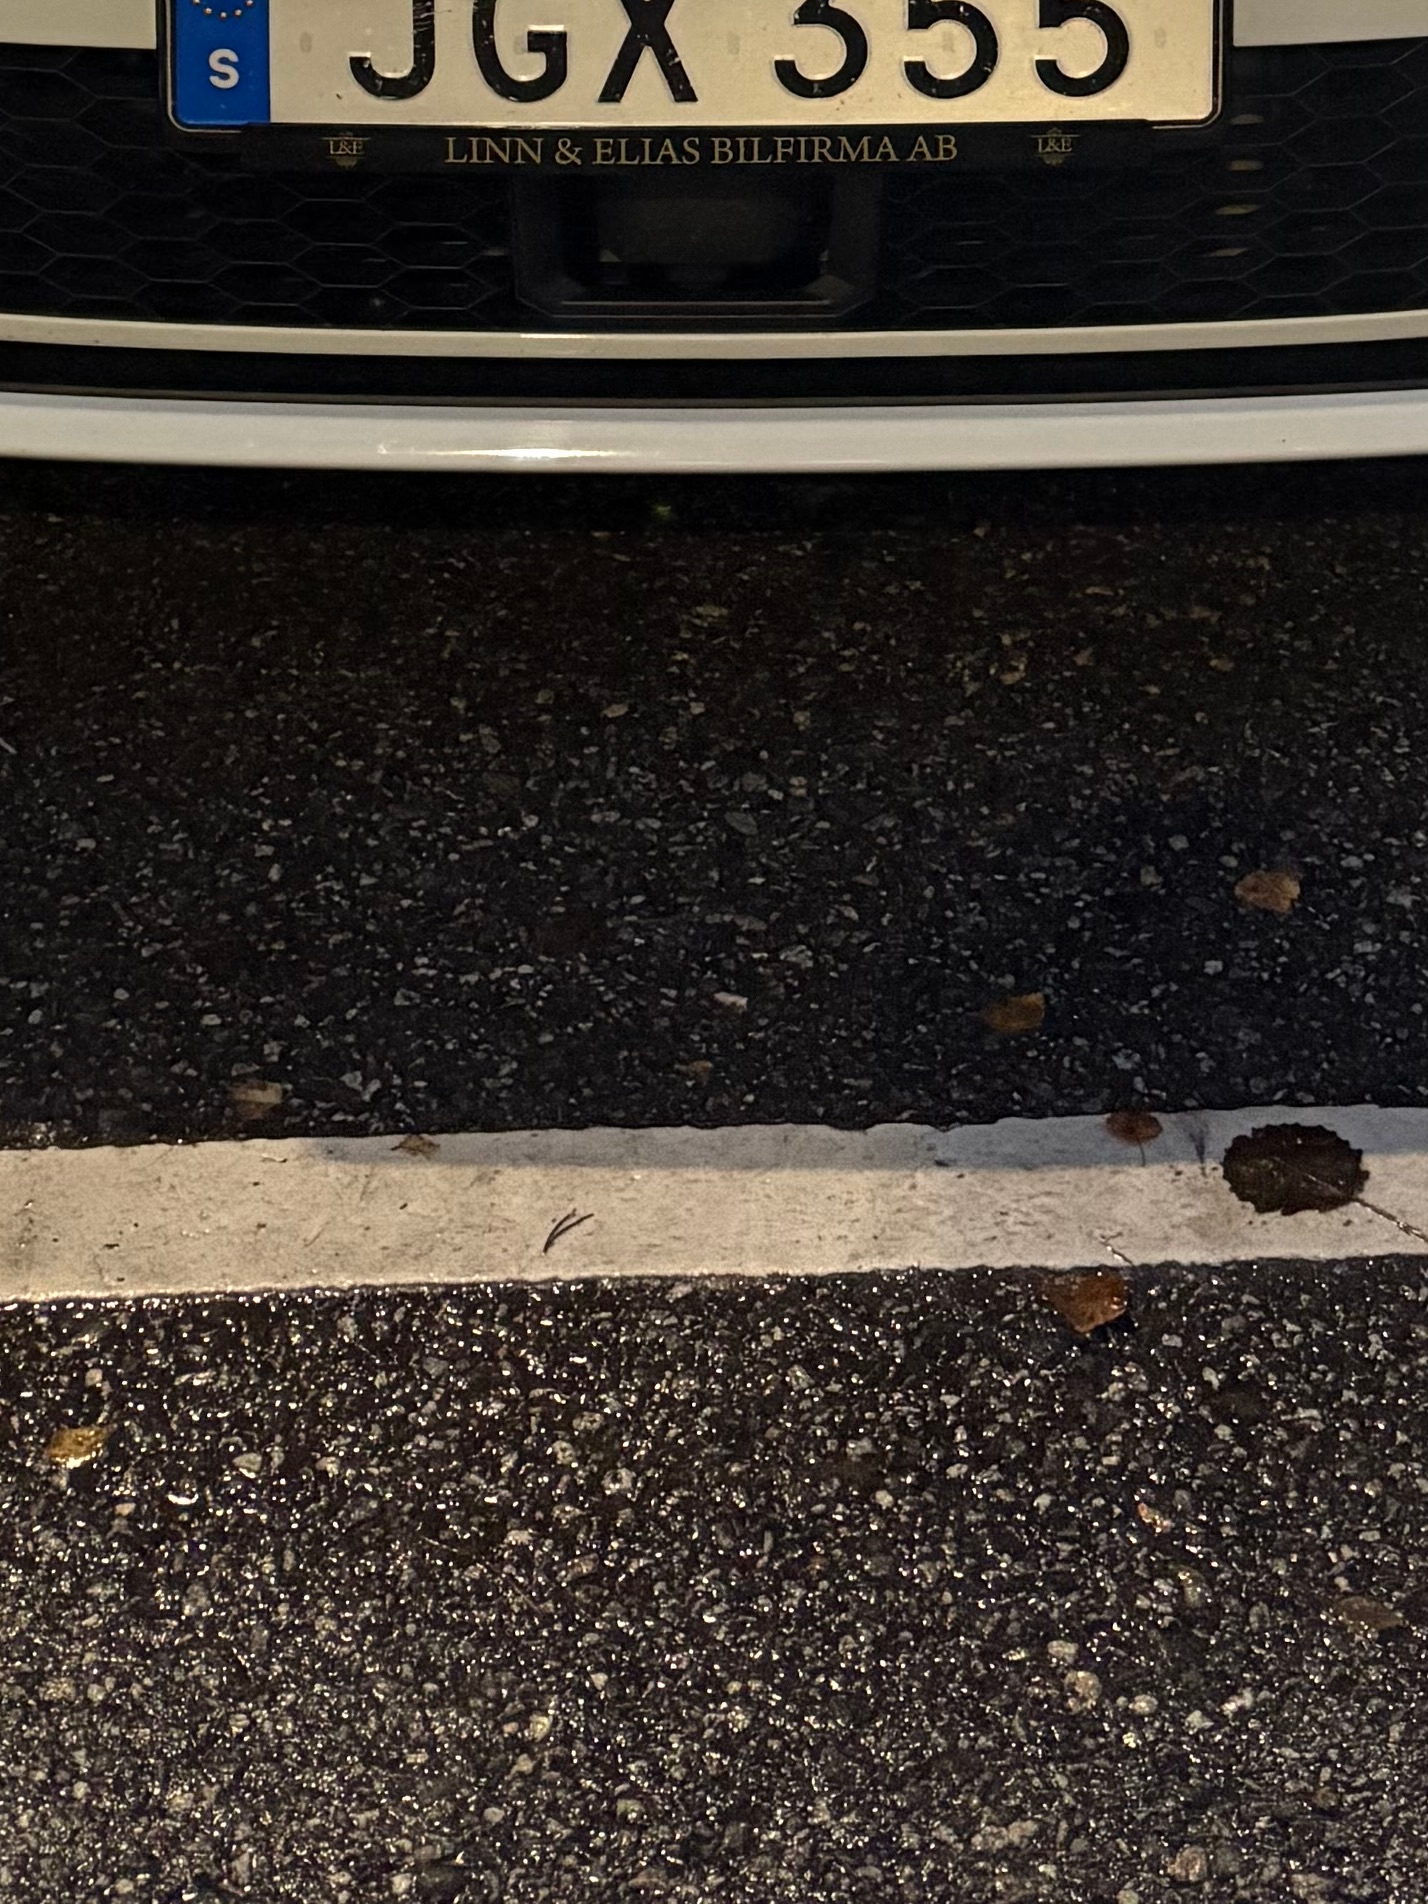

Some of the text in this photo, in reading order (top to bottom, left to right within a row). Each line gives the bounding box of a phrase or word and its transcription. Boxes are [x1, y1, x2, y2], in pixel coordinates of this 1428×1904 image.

[208, 47, 240, 89] S
[329, 139, 365, 155] L&E
[444, 134, 959, 166] LINN & ELIAS BILFIRMA AB
[1037, 137, 1073, 153] L&E
